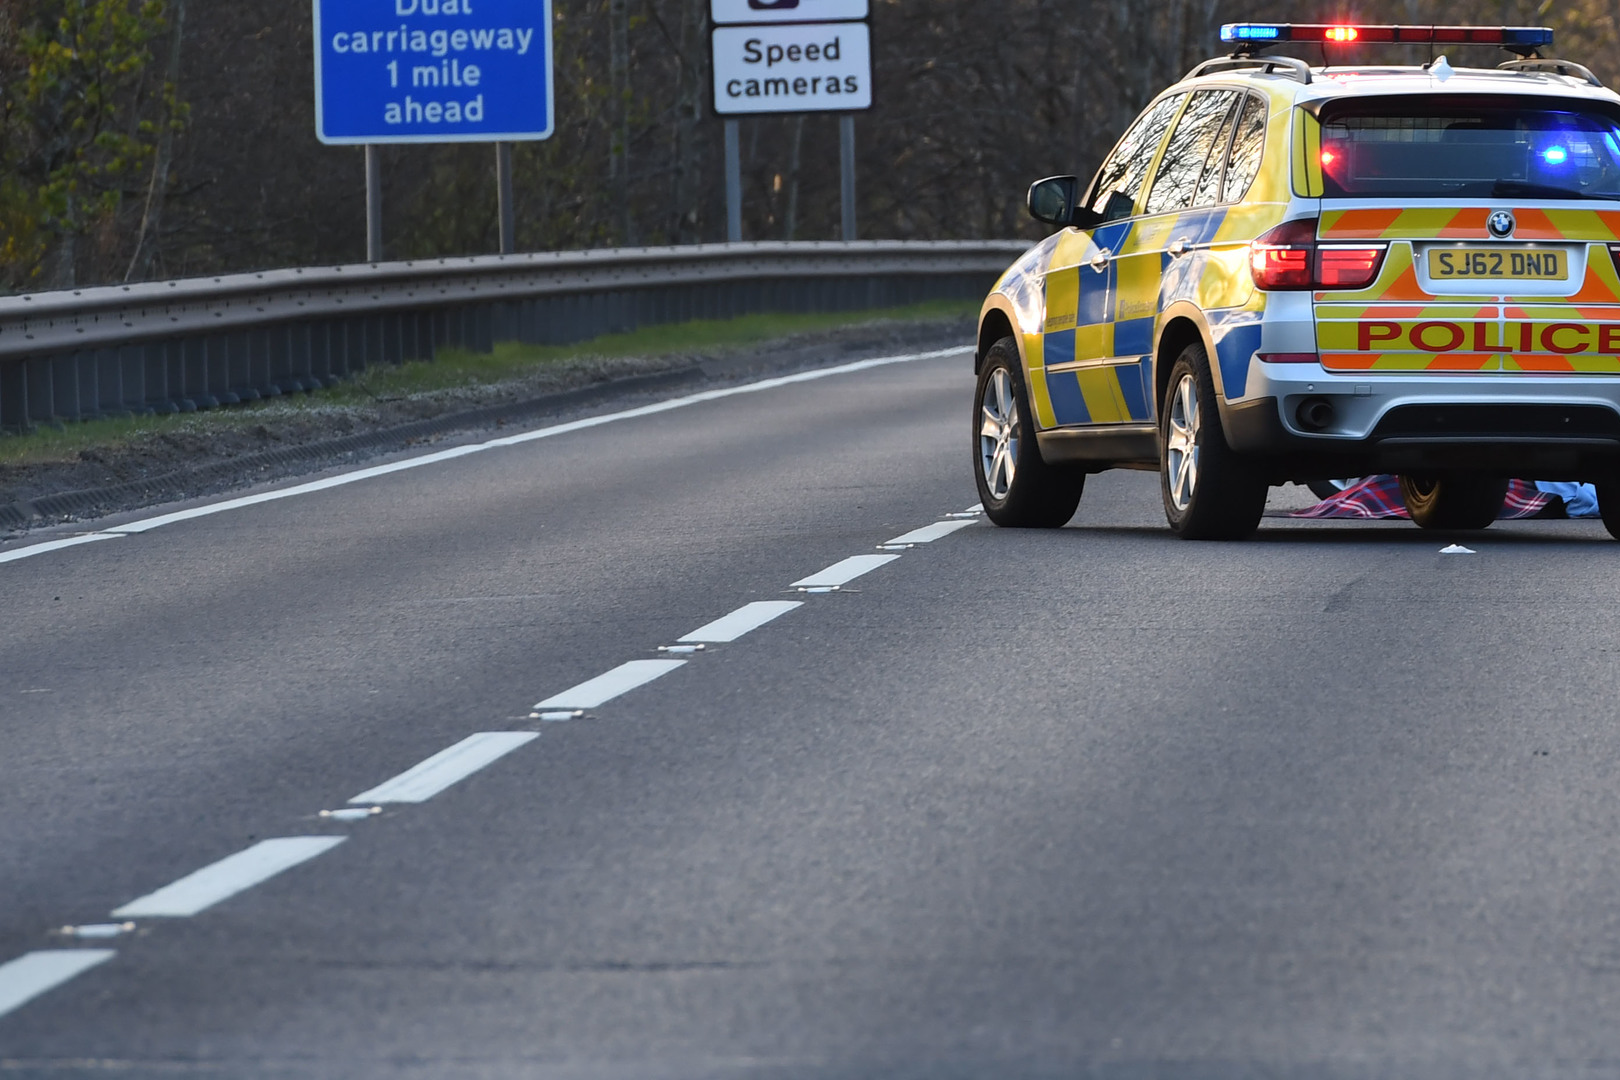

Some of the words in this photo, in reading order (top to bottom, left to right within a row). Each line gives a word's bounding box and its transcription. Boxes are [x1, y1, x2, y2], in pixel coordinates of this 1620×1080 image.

[333, 25, 533, 56] carriageway
[743, 37, 840, 67] Speed
[386, 61, 398, 88] 1
[413, 60, 480, 86] mile
[726, 76, 858, 98] cameras
[385, 95, 483, 123] ahead
[1439, 253, 1503, 275] SJ62
[1509, 253, 1557, 275] DND
